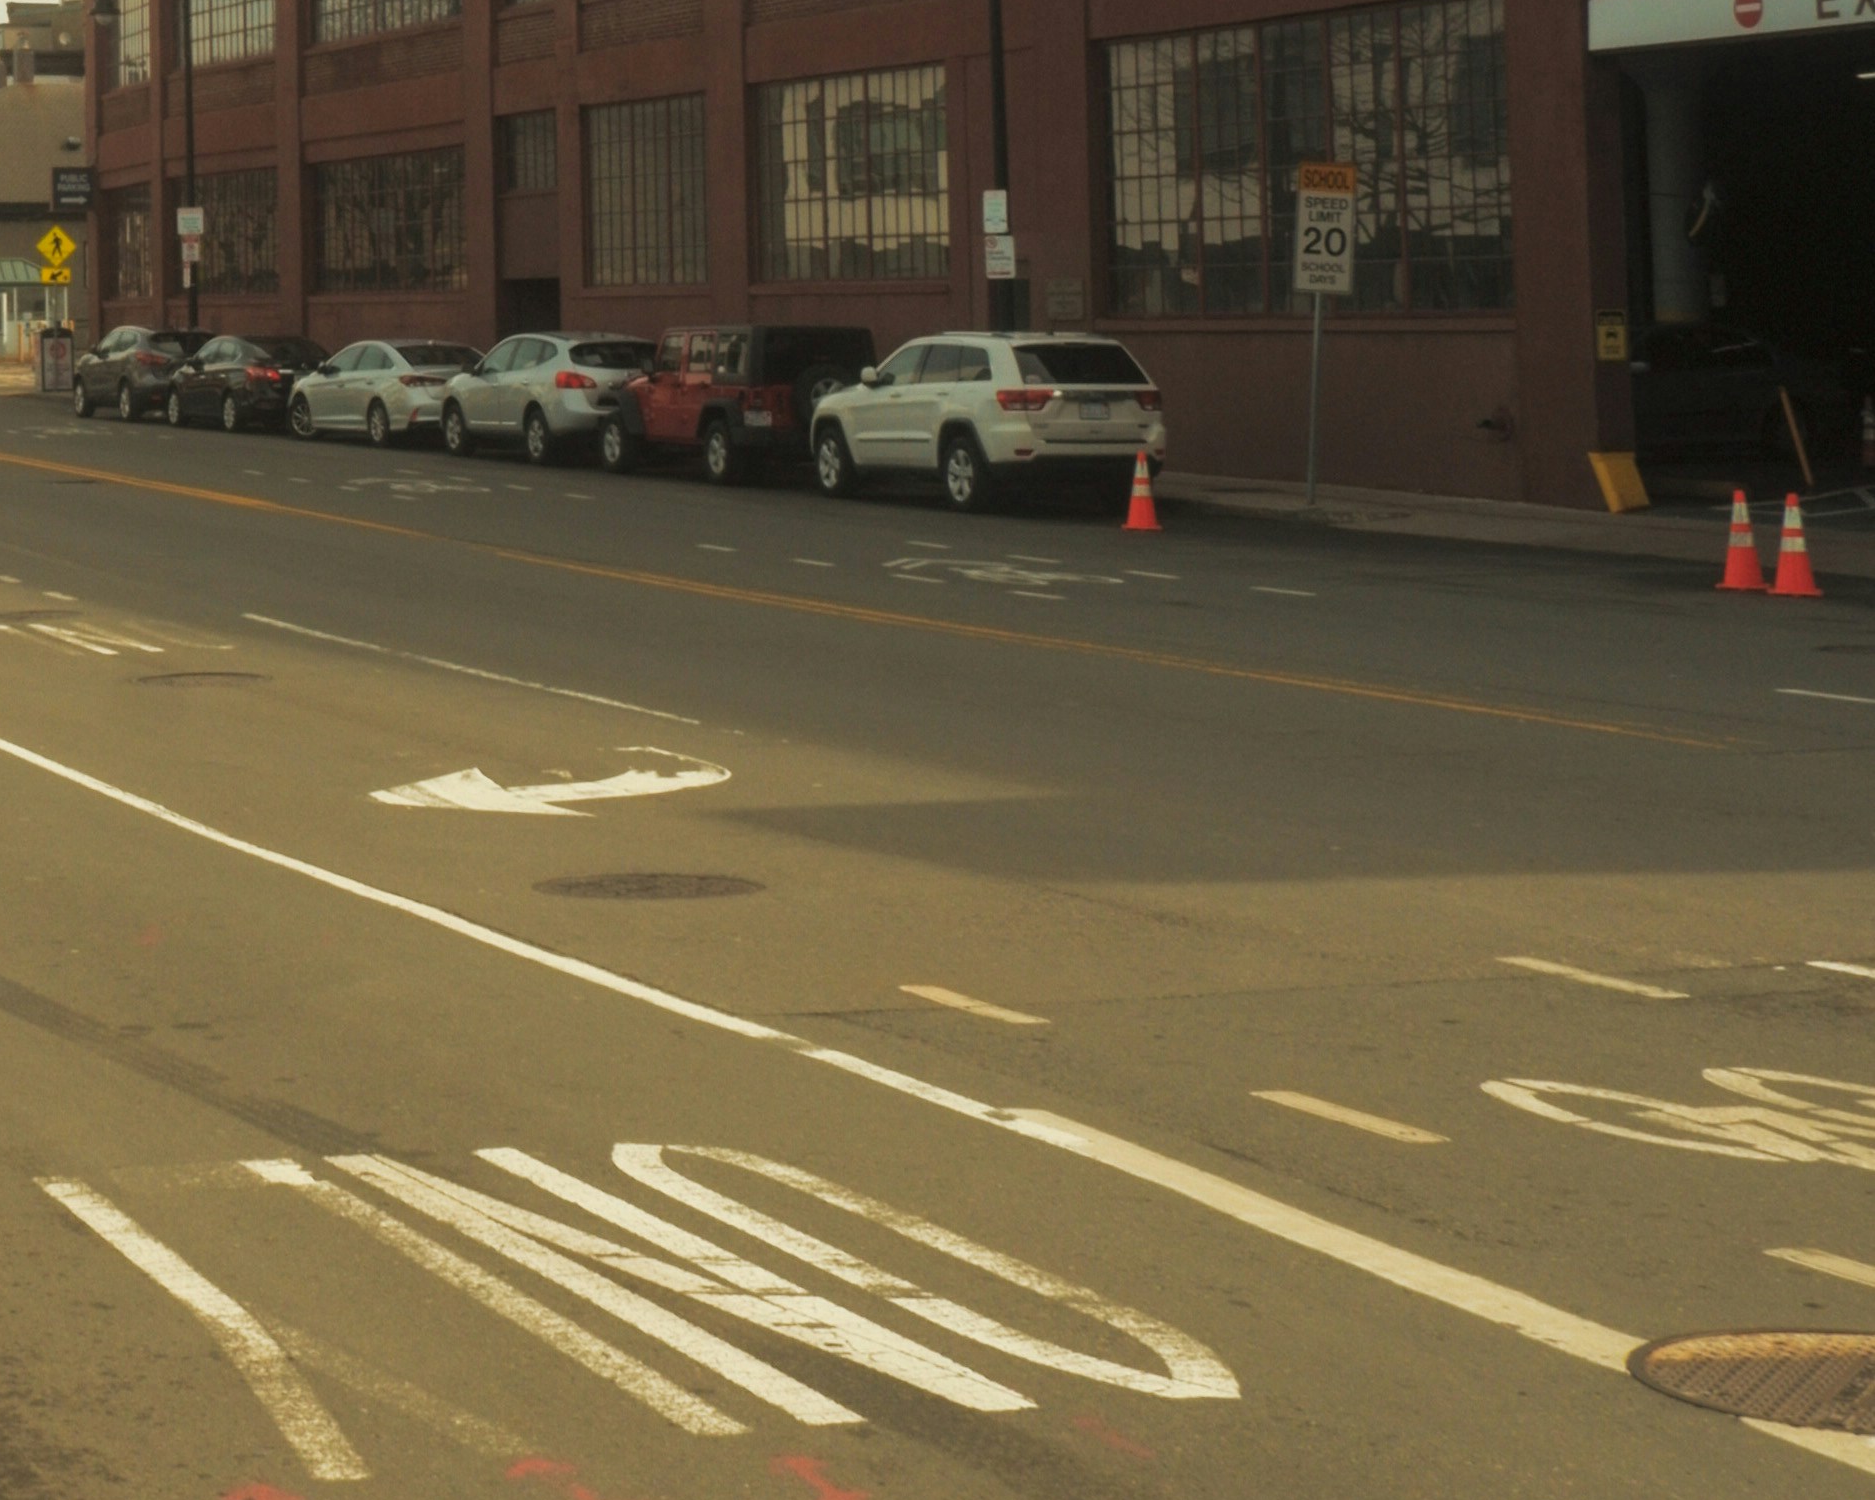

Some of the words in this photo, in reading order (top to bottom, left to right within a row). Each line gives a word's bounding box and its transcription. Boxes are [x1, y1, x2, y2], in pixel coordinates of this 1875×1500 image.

[1304, 168, 1351, 189] SCHOOL
[1305, 195, 1348, 210] SPEED
[1308, 210, 1342, 223] LIMIT
[1303, 227, 1347, 257] 20
[1301, 261, 1346, 274] SCHOOL
[1309, 274, 1337, 286] DAYS
